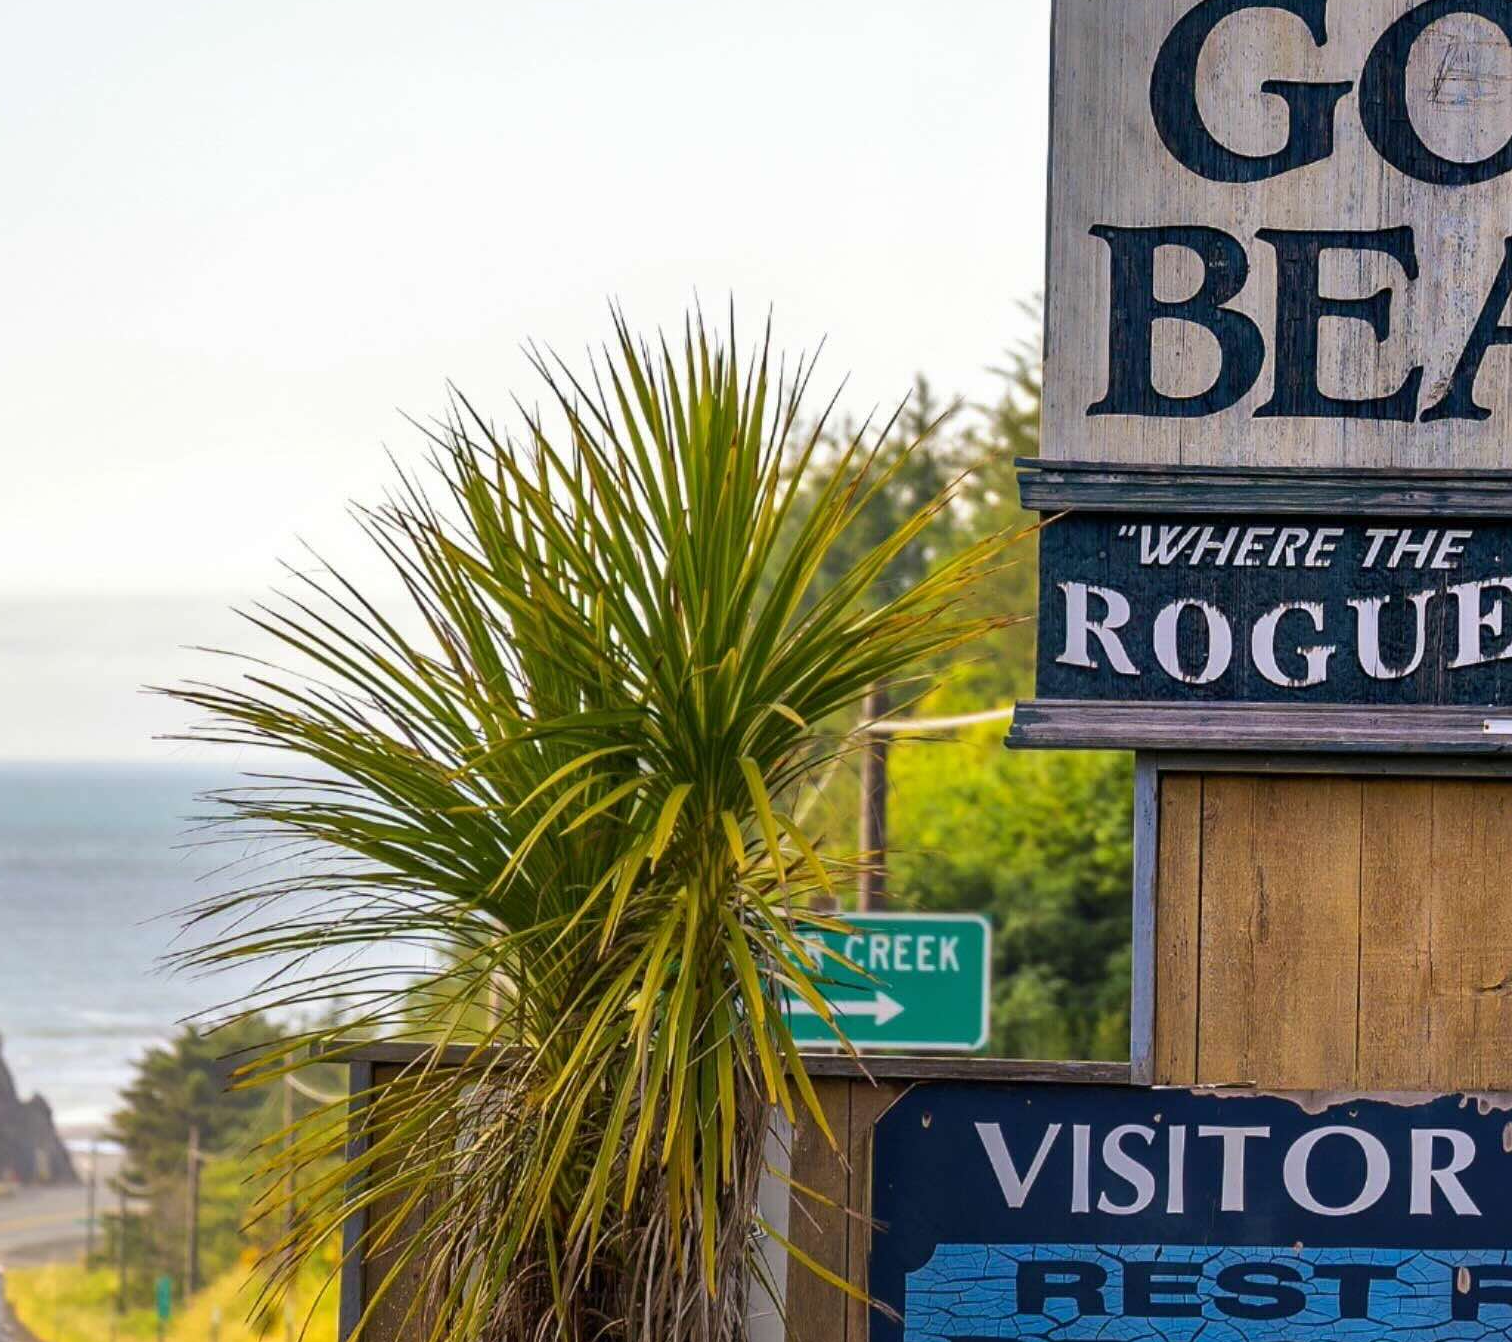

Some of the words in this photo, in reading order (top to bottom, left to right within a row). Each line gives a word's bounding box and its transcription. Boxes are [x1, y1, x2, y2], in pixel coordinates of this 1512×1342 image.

[1361, 528, 1473, 570] THE
[844, 934, 960, 971] CREEK
[974, 1121, 1481, 1217] VISITOR
[1017, 1260, 1398, 1323] REST
